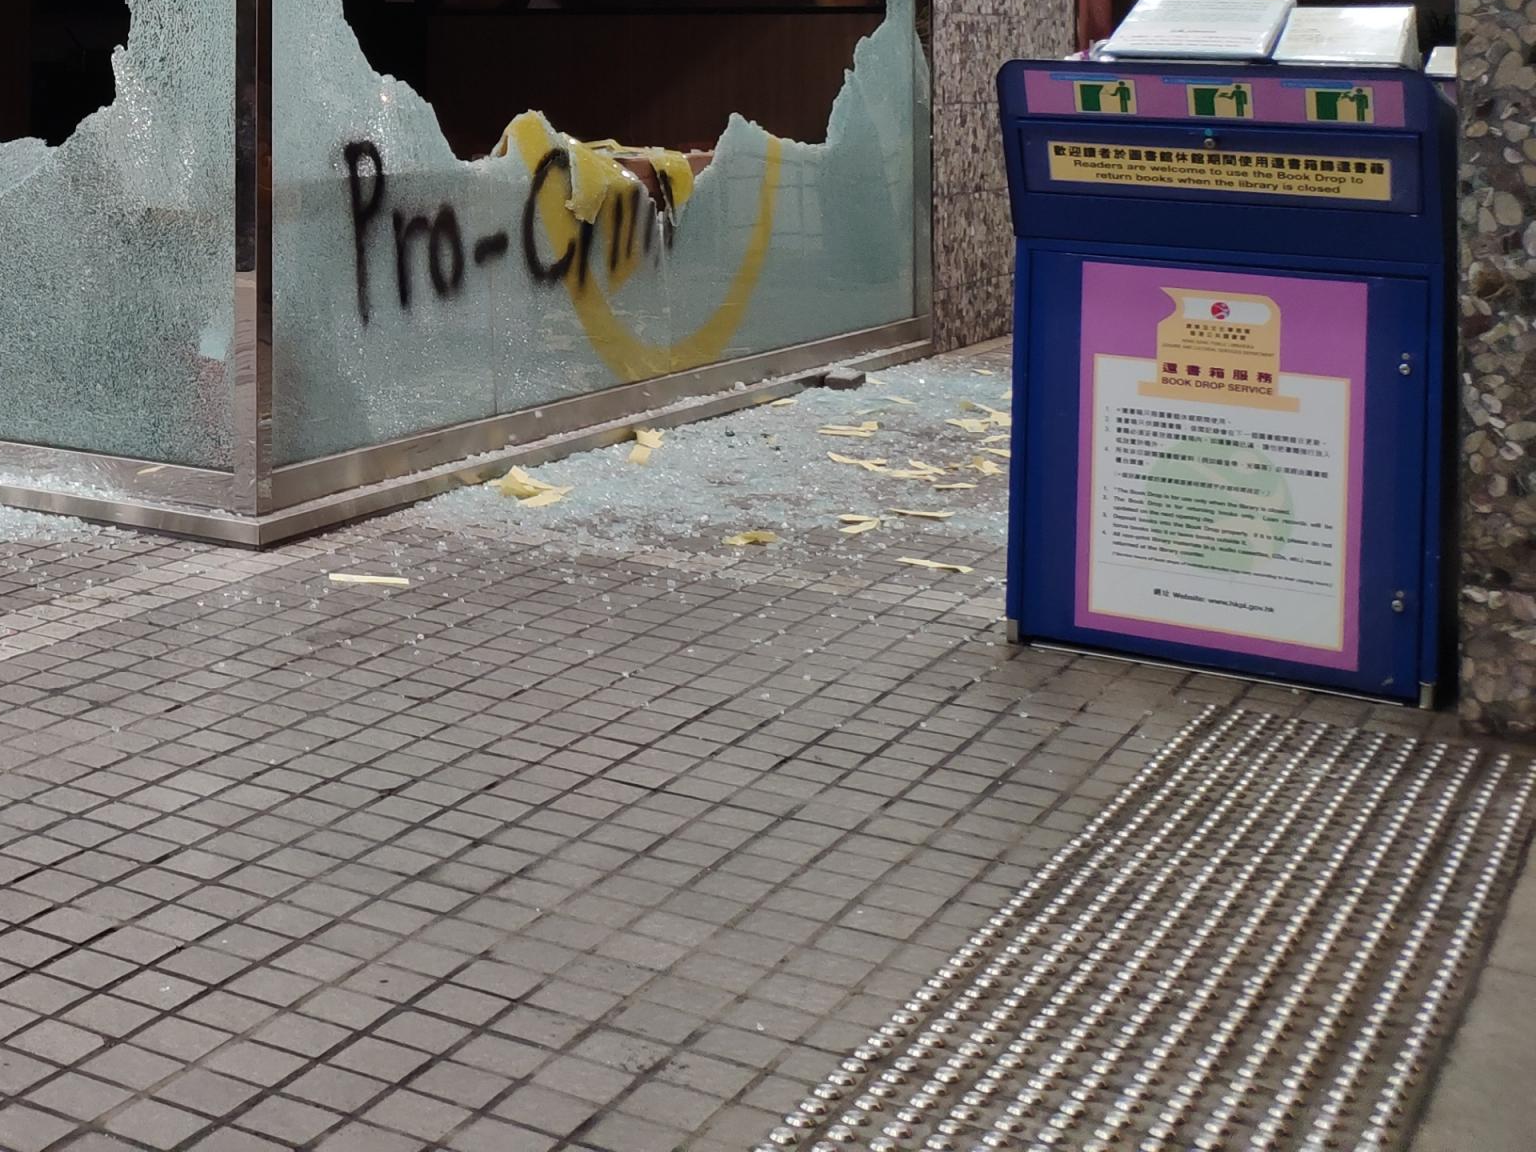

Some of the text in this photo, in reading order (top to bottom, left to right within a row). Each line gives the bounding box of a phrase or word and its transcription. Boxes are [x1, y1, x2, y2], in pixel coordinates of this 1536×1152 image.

[1073, 159, 1364, 184] Readers are welcome to use the Book Drop to
[1096, 172, 1341, 194] return books when the library is closed
[1161, 376, 1273, 396] BOOK DROP SERVICE
